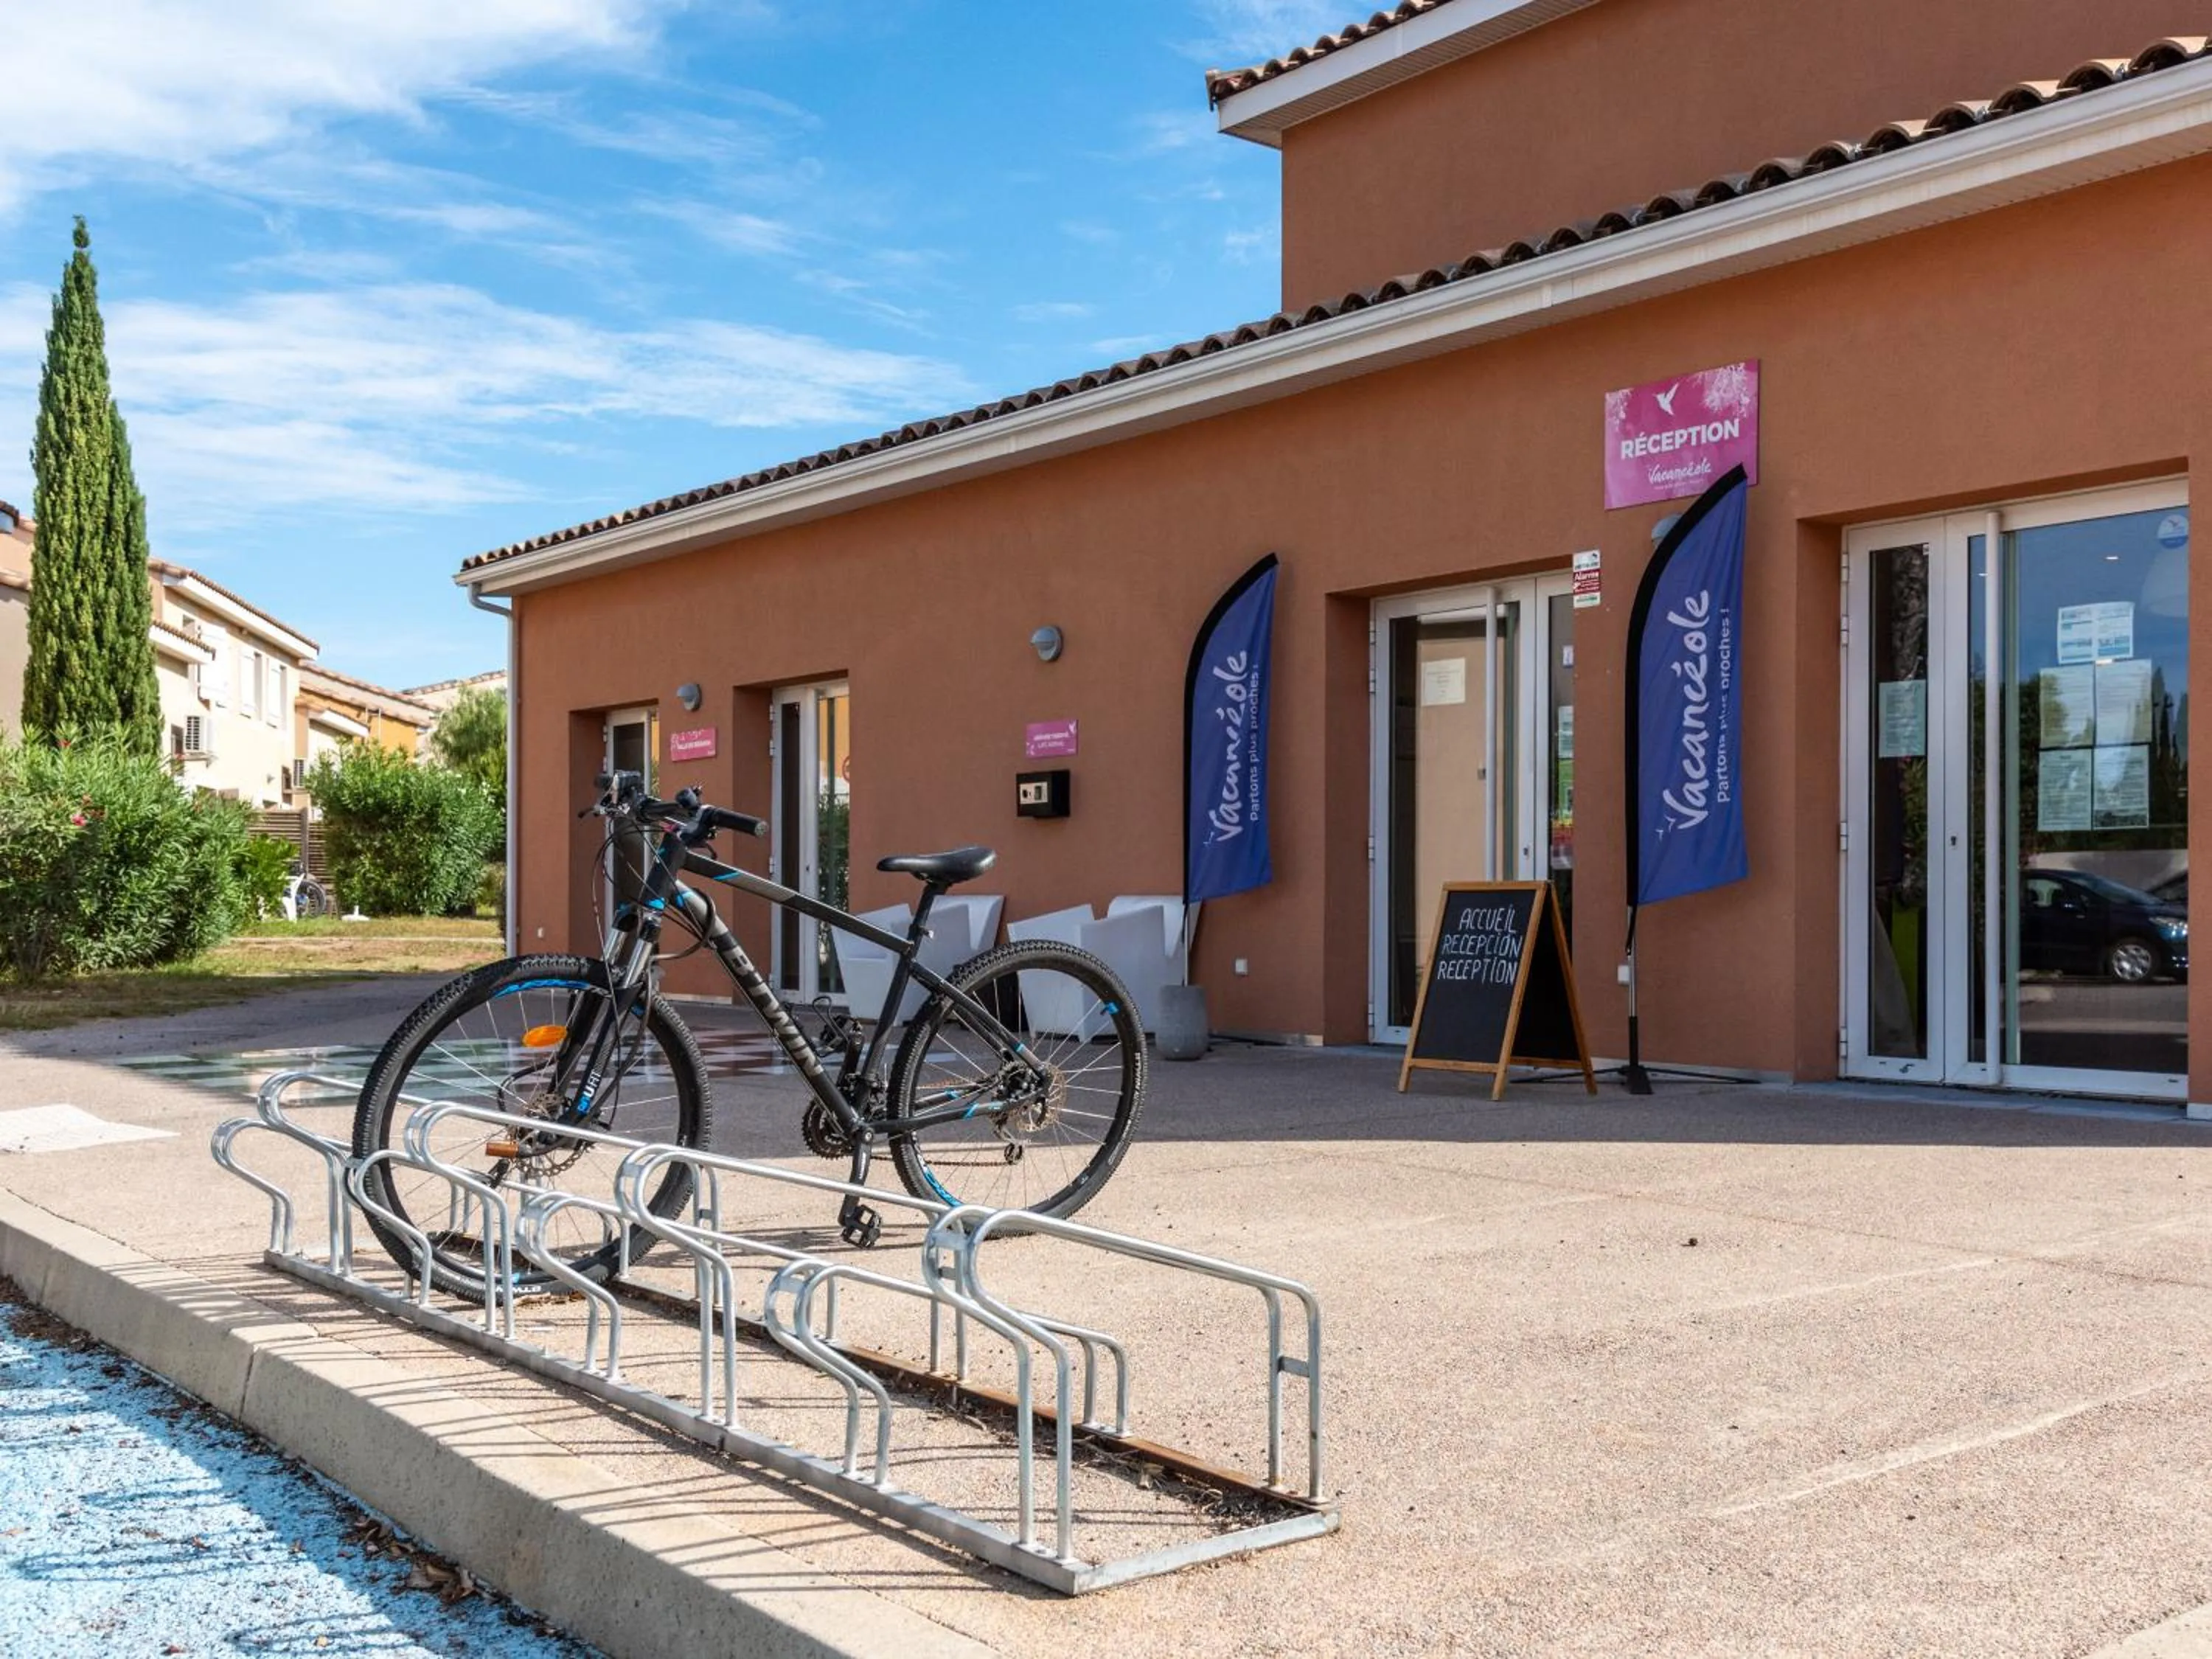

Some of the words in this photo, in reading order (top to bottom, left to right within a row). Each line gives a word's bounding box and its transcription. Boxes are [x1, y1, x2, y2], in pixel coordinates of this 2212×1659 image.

[1621, 418, 1739, 460] RÉCEPTION
[1663, 589, 1709, 830] Vacancéole
[1208, 650, 1248, 841] Vacancéole
[1458, 904, 1517, 933] ACCUEIL
[1437, 956, 1518, 985] RECEPTION
